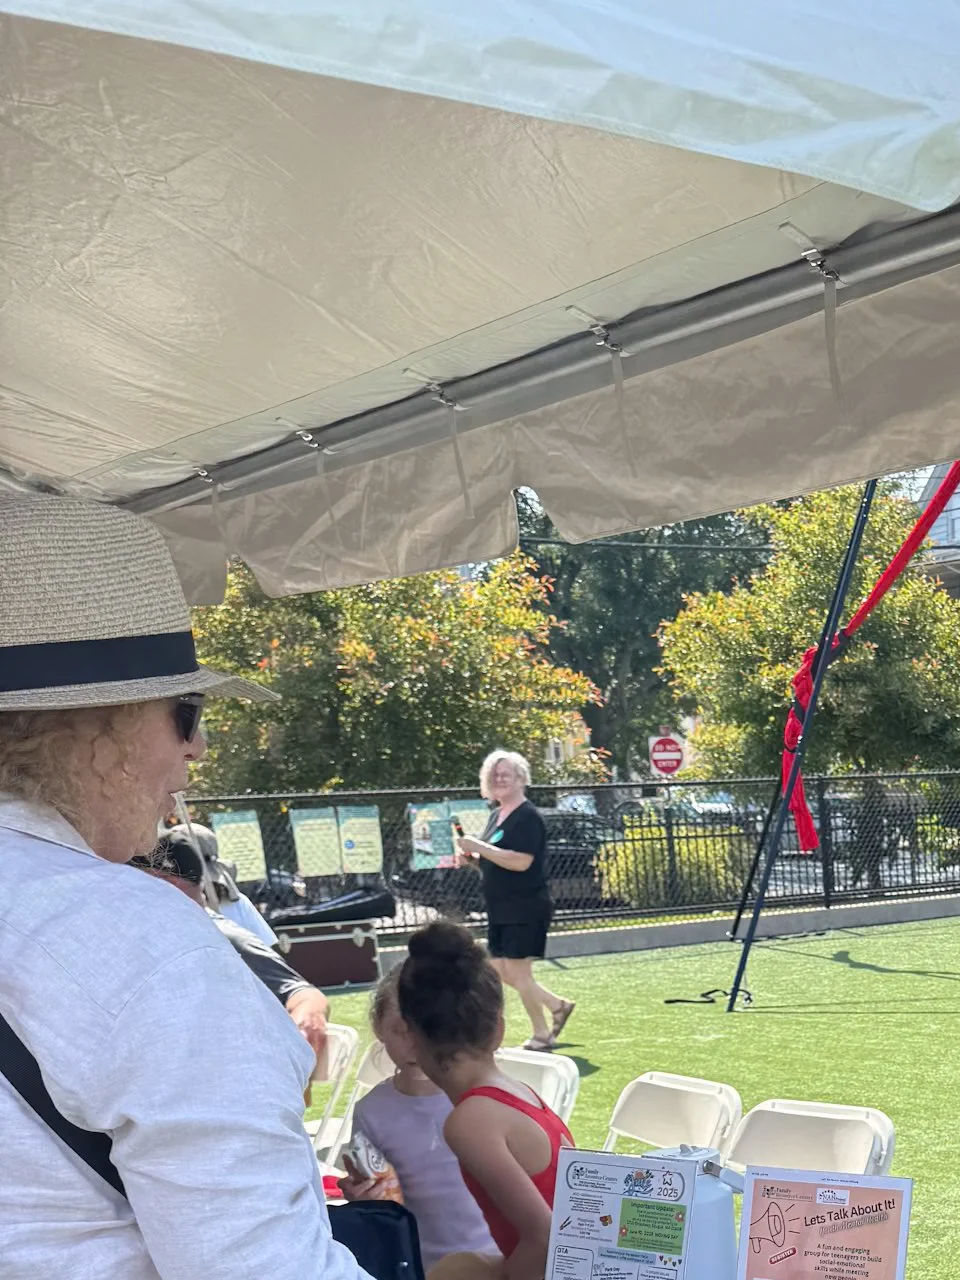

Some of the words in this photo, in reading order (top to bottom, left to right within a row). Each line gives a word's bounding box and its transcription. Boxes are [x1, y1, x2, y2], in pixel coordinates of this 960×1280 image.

[657, 1187, 679, 1198] 2025
[804, 1216, 826, 1227] Lets
[827, 1208, 849, 1222] Talk
[850, 1202, 883, 1218] About
[884, 1198, 896, 1211] It!
[845, 1247, 870, 1255] engaging
[831, 1253, 858, 1261] teenagers
[845, 1269, 869, 1277] meeting
